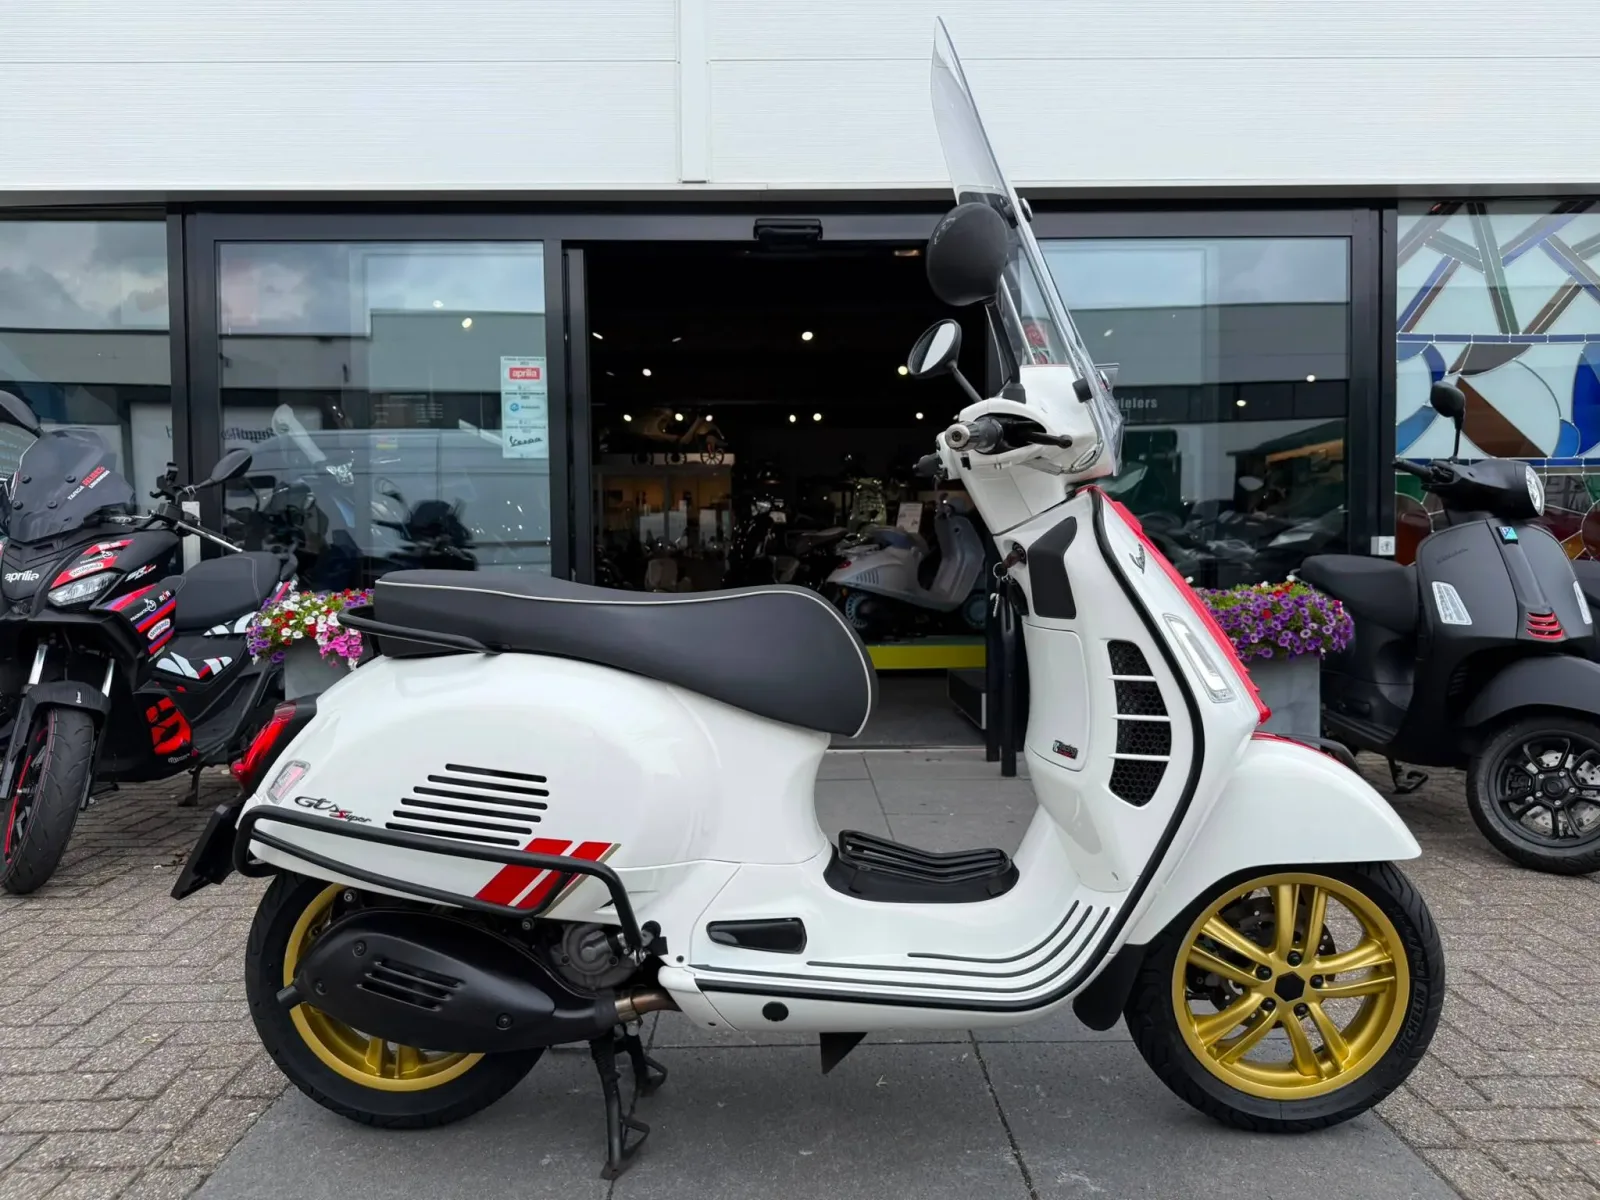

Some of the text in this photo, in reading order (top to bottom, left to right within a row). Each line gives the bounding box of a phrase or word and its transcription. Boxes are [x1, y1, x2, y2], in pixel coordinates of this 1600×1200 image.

[511, 368, 538, 379] aprilia
[4, 570, 40, 583] aprilia
[1396, 987, 1427, 1057] MICHELIN
